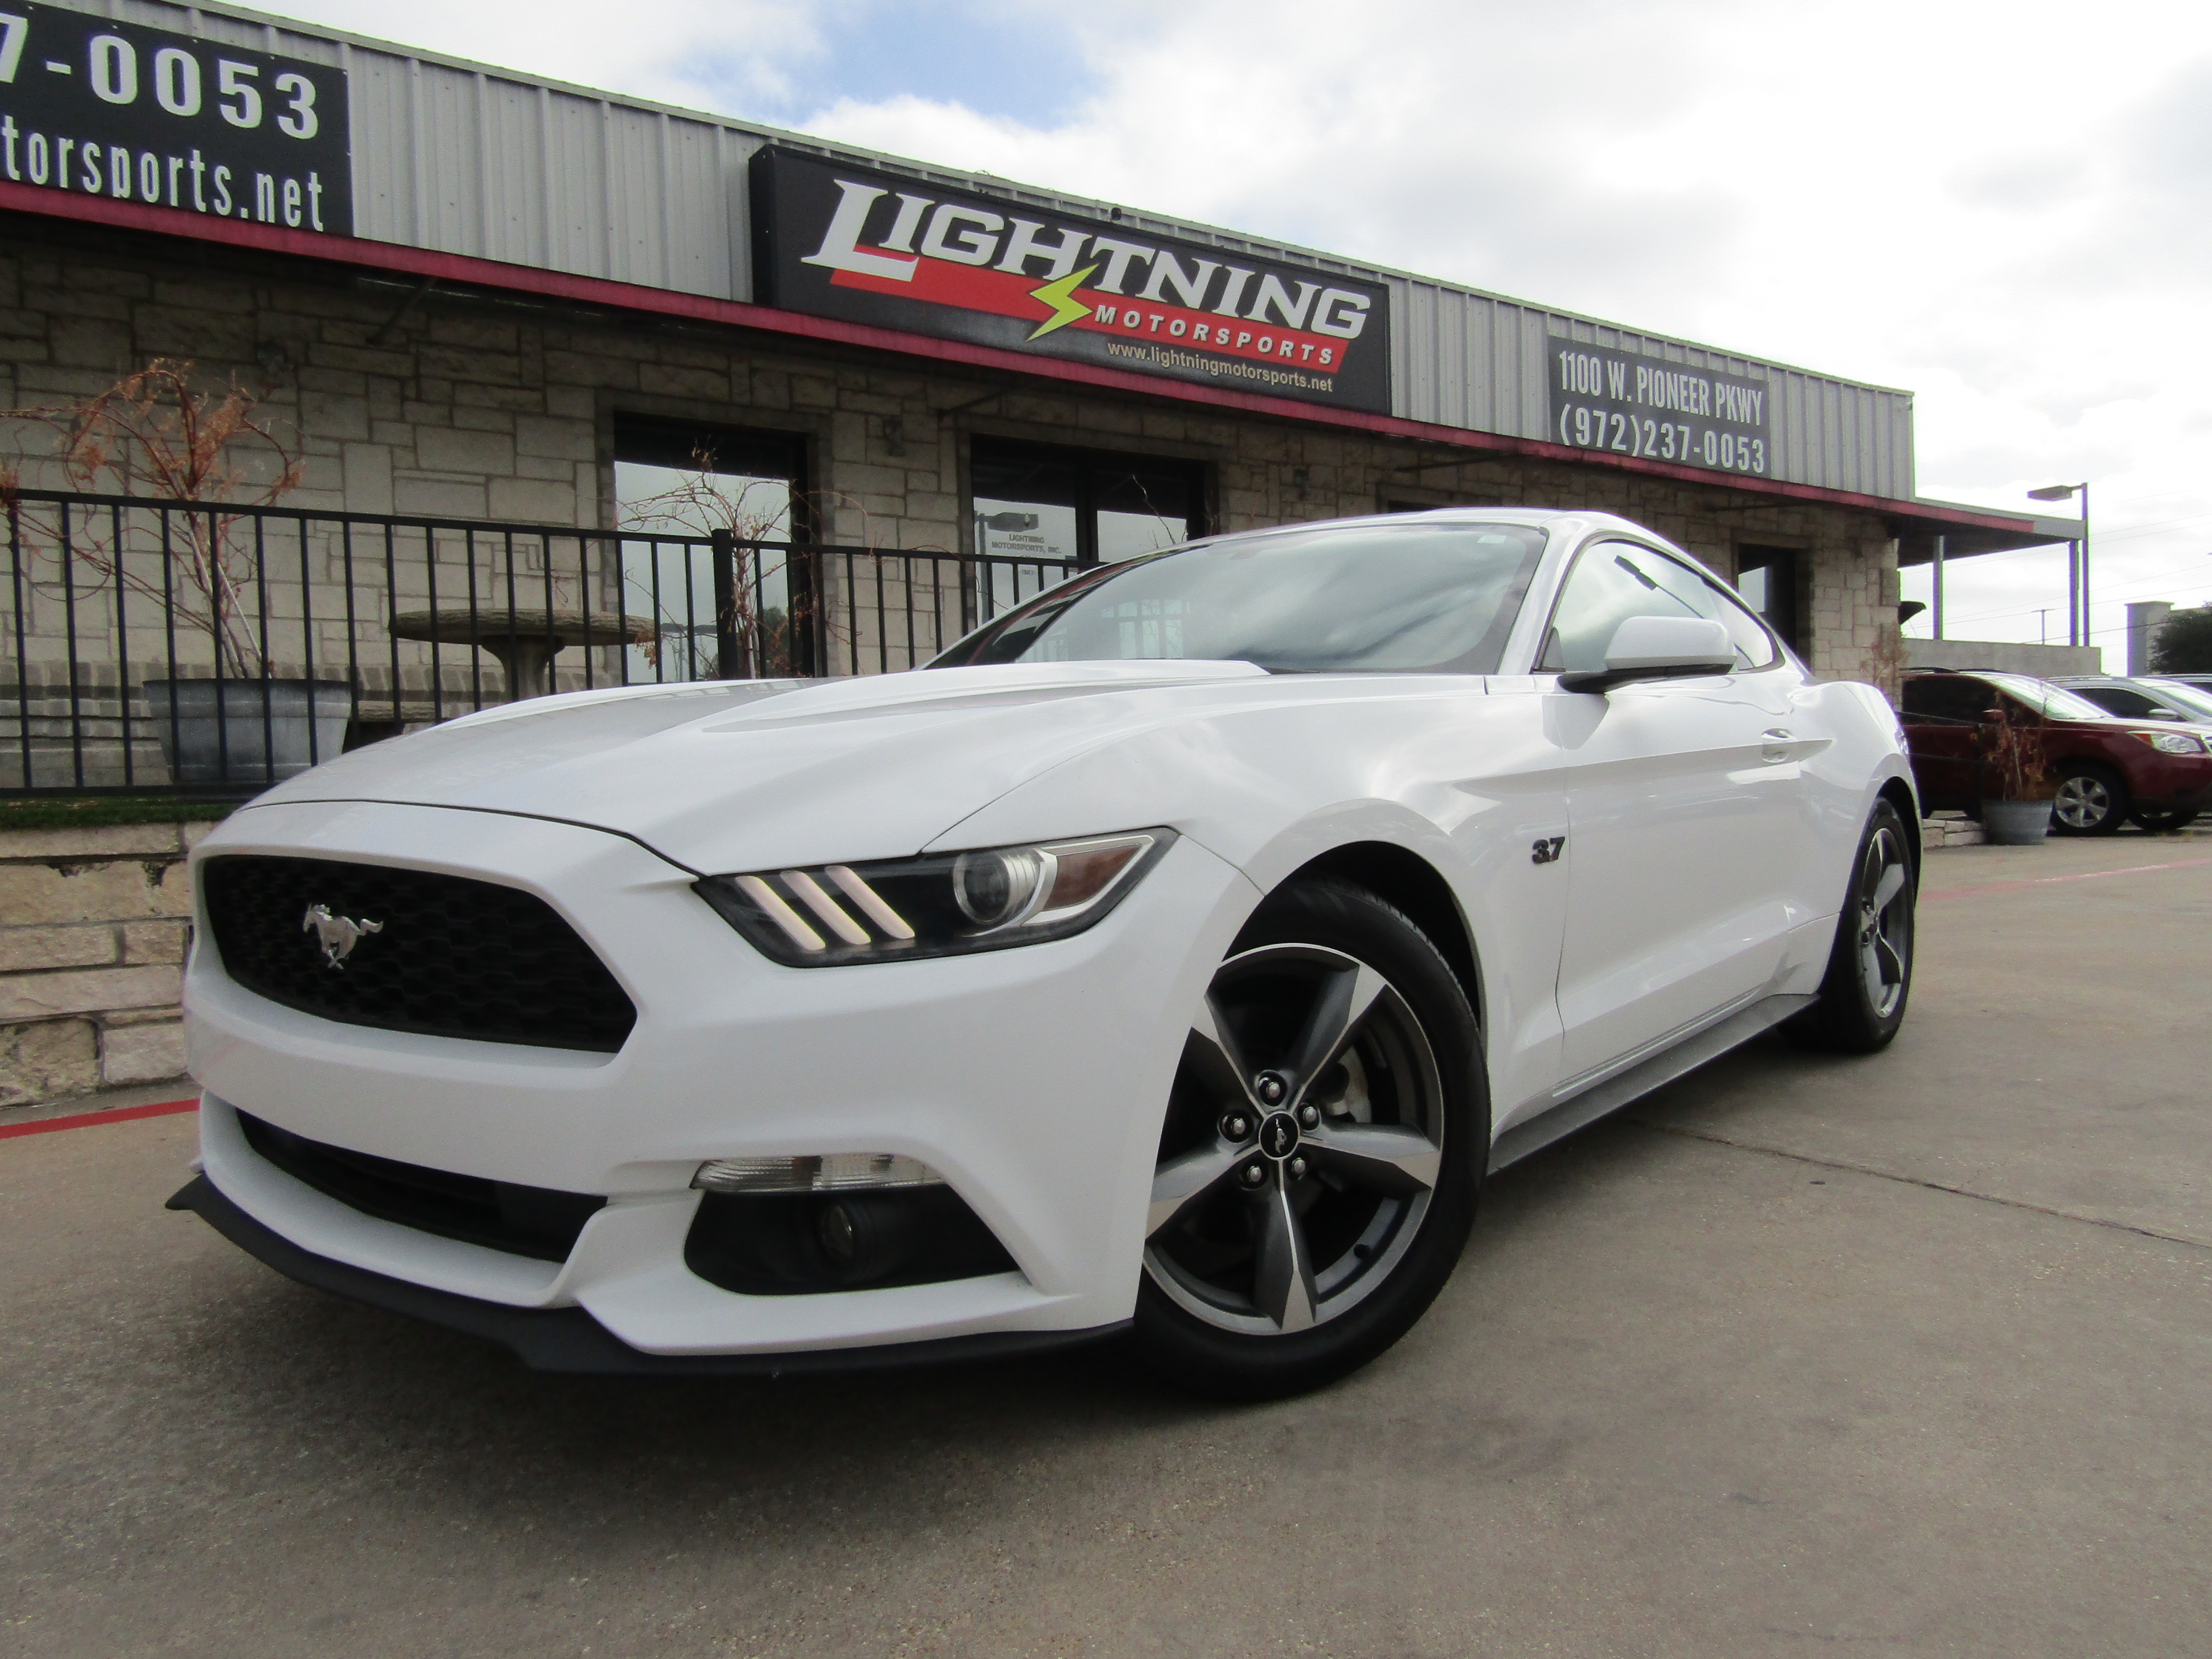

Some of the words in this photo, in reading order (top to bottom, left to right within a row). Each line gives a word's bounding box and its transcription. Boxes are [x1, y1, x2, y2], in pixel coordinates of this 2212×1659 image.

[1, 115, 324, 232] torsports.net
[801, 179, 1370, 339] LIGHTNING
[1094, 304, 1333, 365] MOTORSPORTS
[1107, 341, 1333, 392] www.lightningmotorsports.net
[1559, 350, 1601, 396] 1100
[1607, 360, 1631, 402] W.
[1637, 366, 1710, 416] PIONEER
[1715, 382, 1762, 426] PKWY
[1560, 404, 1764, 473] (972)237-0053
[1009, 534, 1045, 544] LIGHTNING
